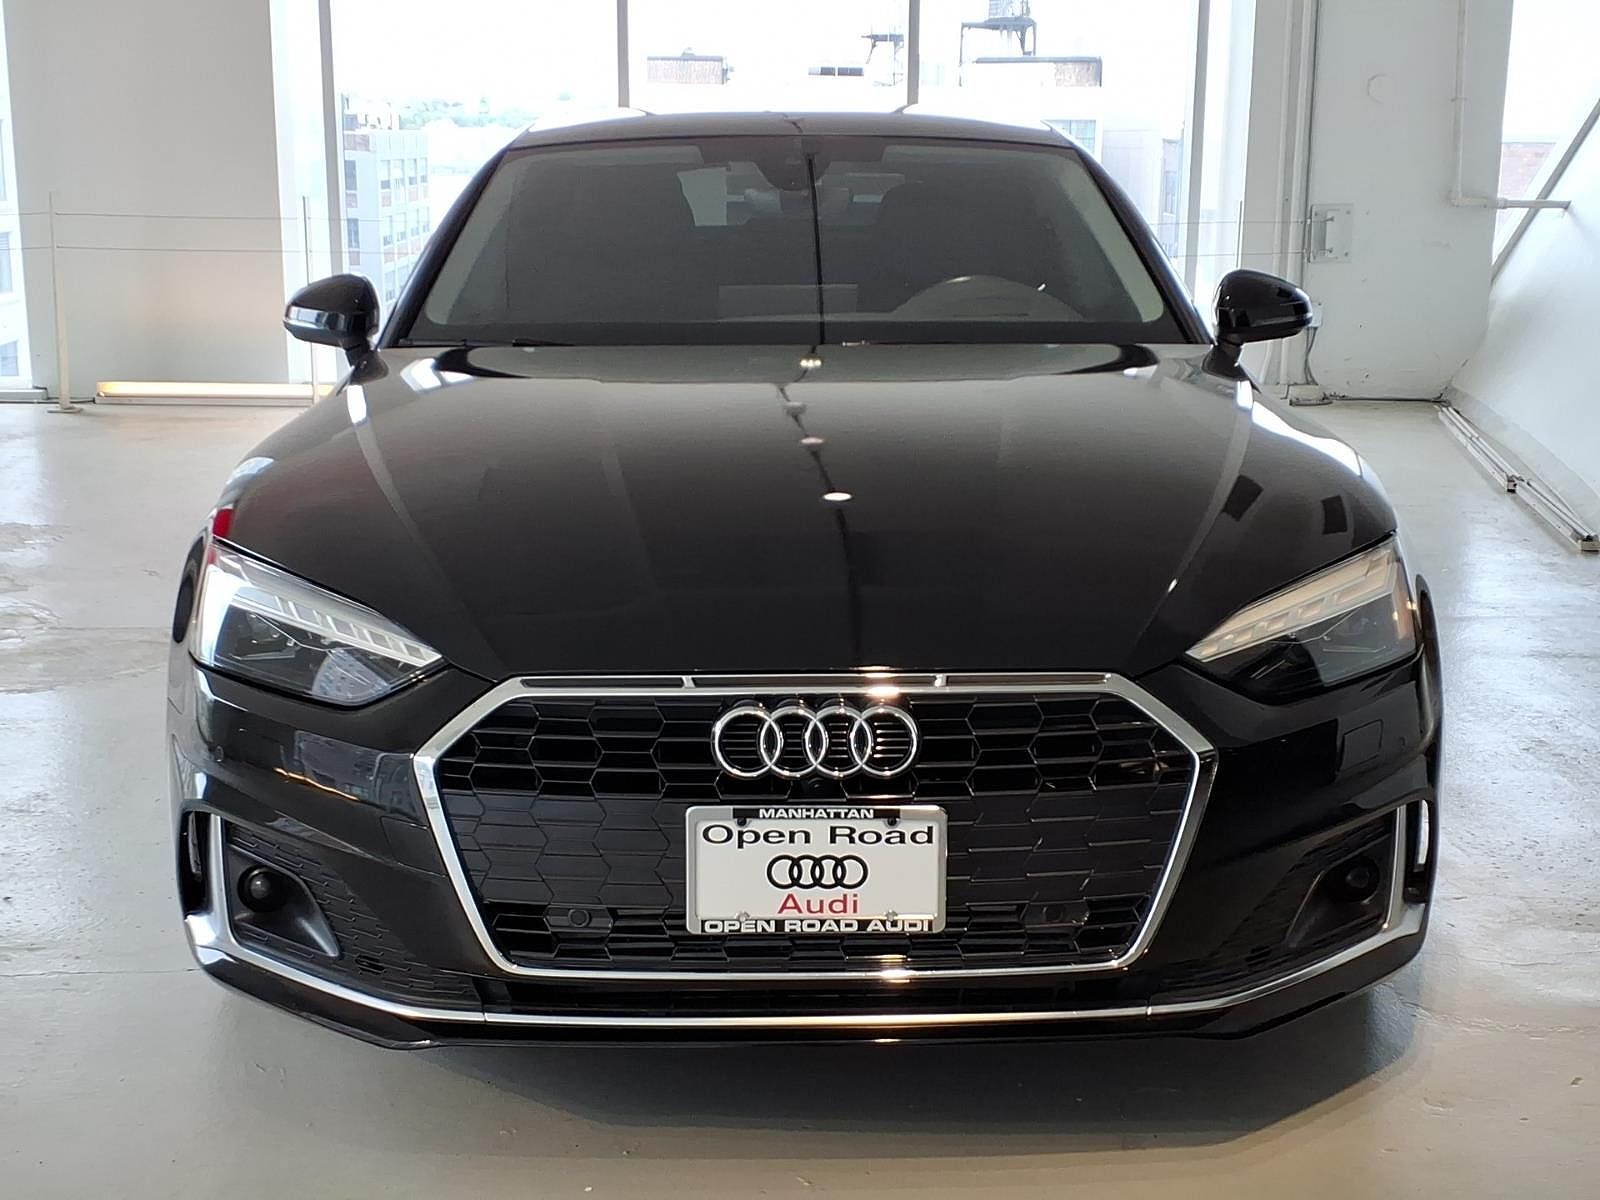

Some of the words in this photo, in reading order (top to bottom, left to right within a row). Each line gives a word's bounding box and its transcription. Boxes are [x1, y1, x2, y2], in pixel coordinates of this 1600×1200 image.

[759, 808, 874, 819] MANHATTAN
[702, 824, 811, 848] Open
[829, 825, 934, 844] Road
[777, 893, 860, 914] Audi
[704, 920, 776, 933] OPEN
[784, 919, 860, 932] ROAD
[866, 919, 930, 932] AUDI
